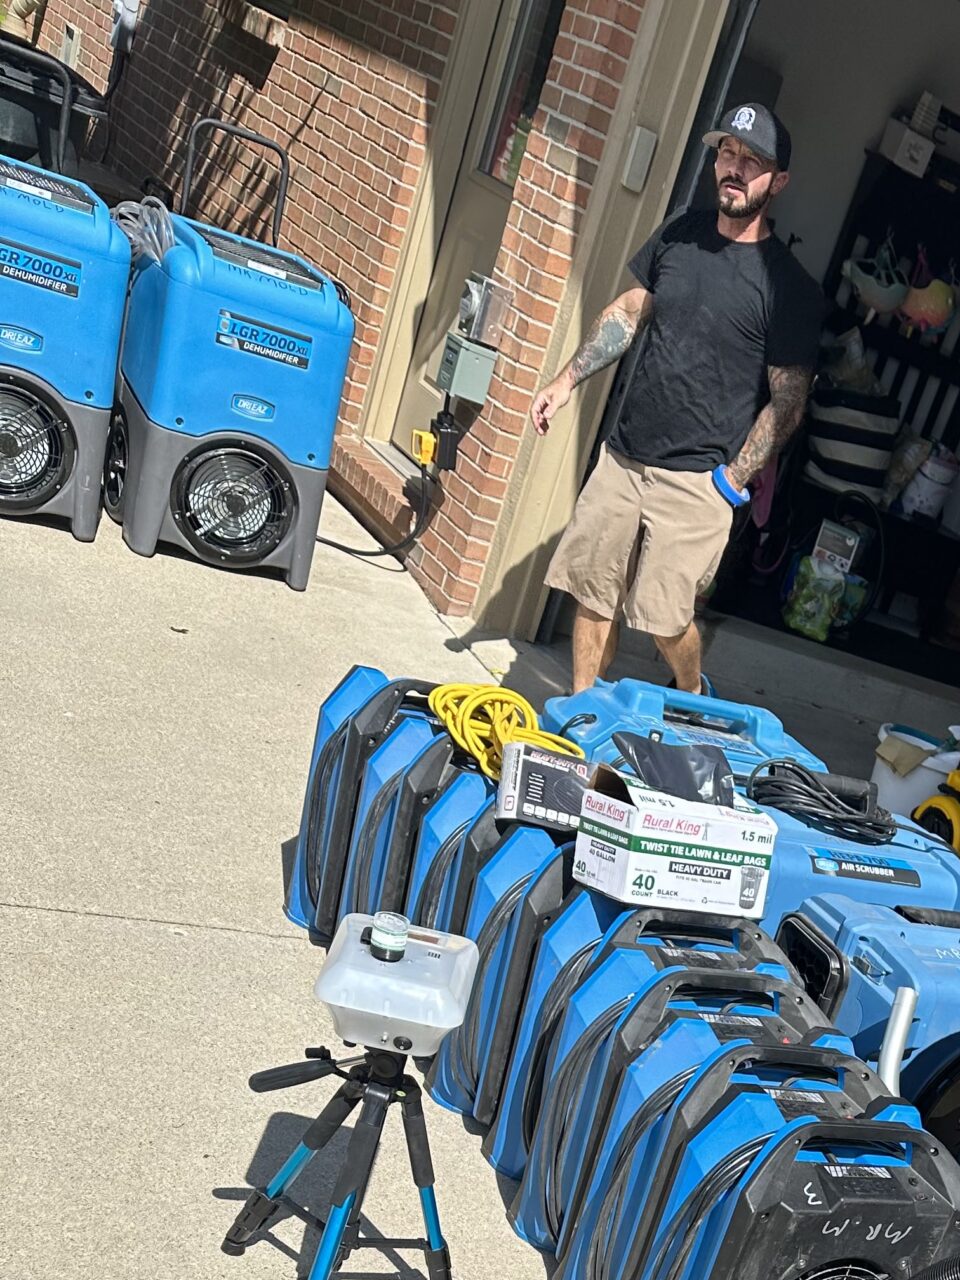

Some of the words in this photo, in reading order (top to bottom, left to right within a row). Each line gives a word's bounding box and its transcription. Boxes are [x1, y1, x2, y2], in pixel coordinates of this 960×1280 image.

[0, 248, 19, 266] GR
[3, 266, 67, 292] DEHUMIDIFIER
[231, 322, 260, 342] LGR
[243, 342, 299, 365] DEHUMIDIFIER
[586, 796, 606, 811] Rural
[606, 803, 625, 822] King
[642, 814, 673, 830] Rural
[675, 819, 701, 836] King
[740, 831, 755, 842] 1.5
[757, 834, 773, 845] mil
[596, 850, 616, 864] GALLON
[640, 841, 669, 853] TWIST
[670, 844, 685, 855] TIE
[685, 846, 712, 860] LAWN
[712, 851, 721, 860] &
[721, 852, 743, 863] LEAF
[743, 855, 767, 867] BAGS
[576, 859, 587, 873] 40
[671, 863, 703, 876] HEAVY
[703, 867, 729, 879] DUTY
[841, 862, 855, 871] AIR
[856, 864, 895, 877] SCRUBBER
[632, 873, 655, 891] 40
[631, 890, 653, 898] COUNT
[657, 889, 679, 897] BLACK
[742, 888, 755, 897] 40
